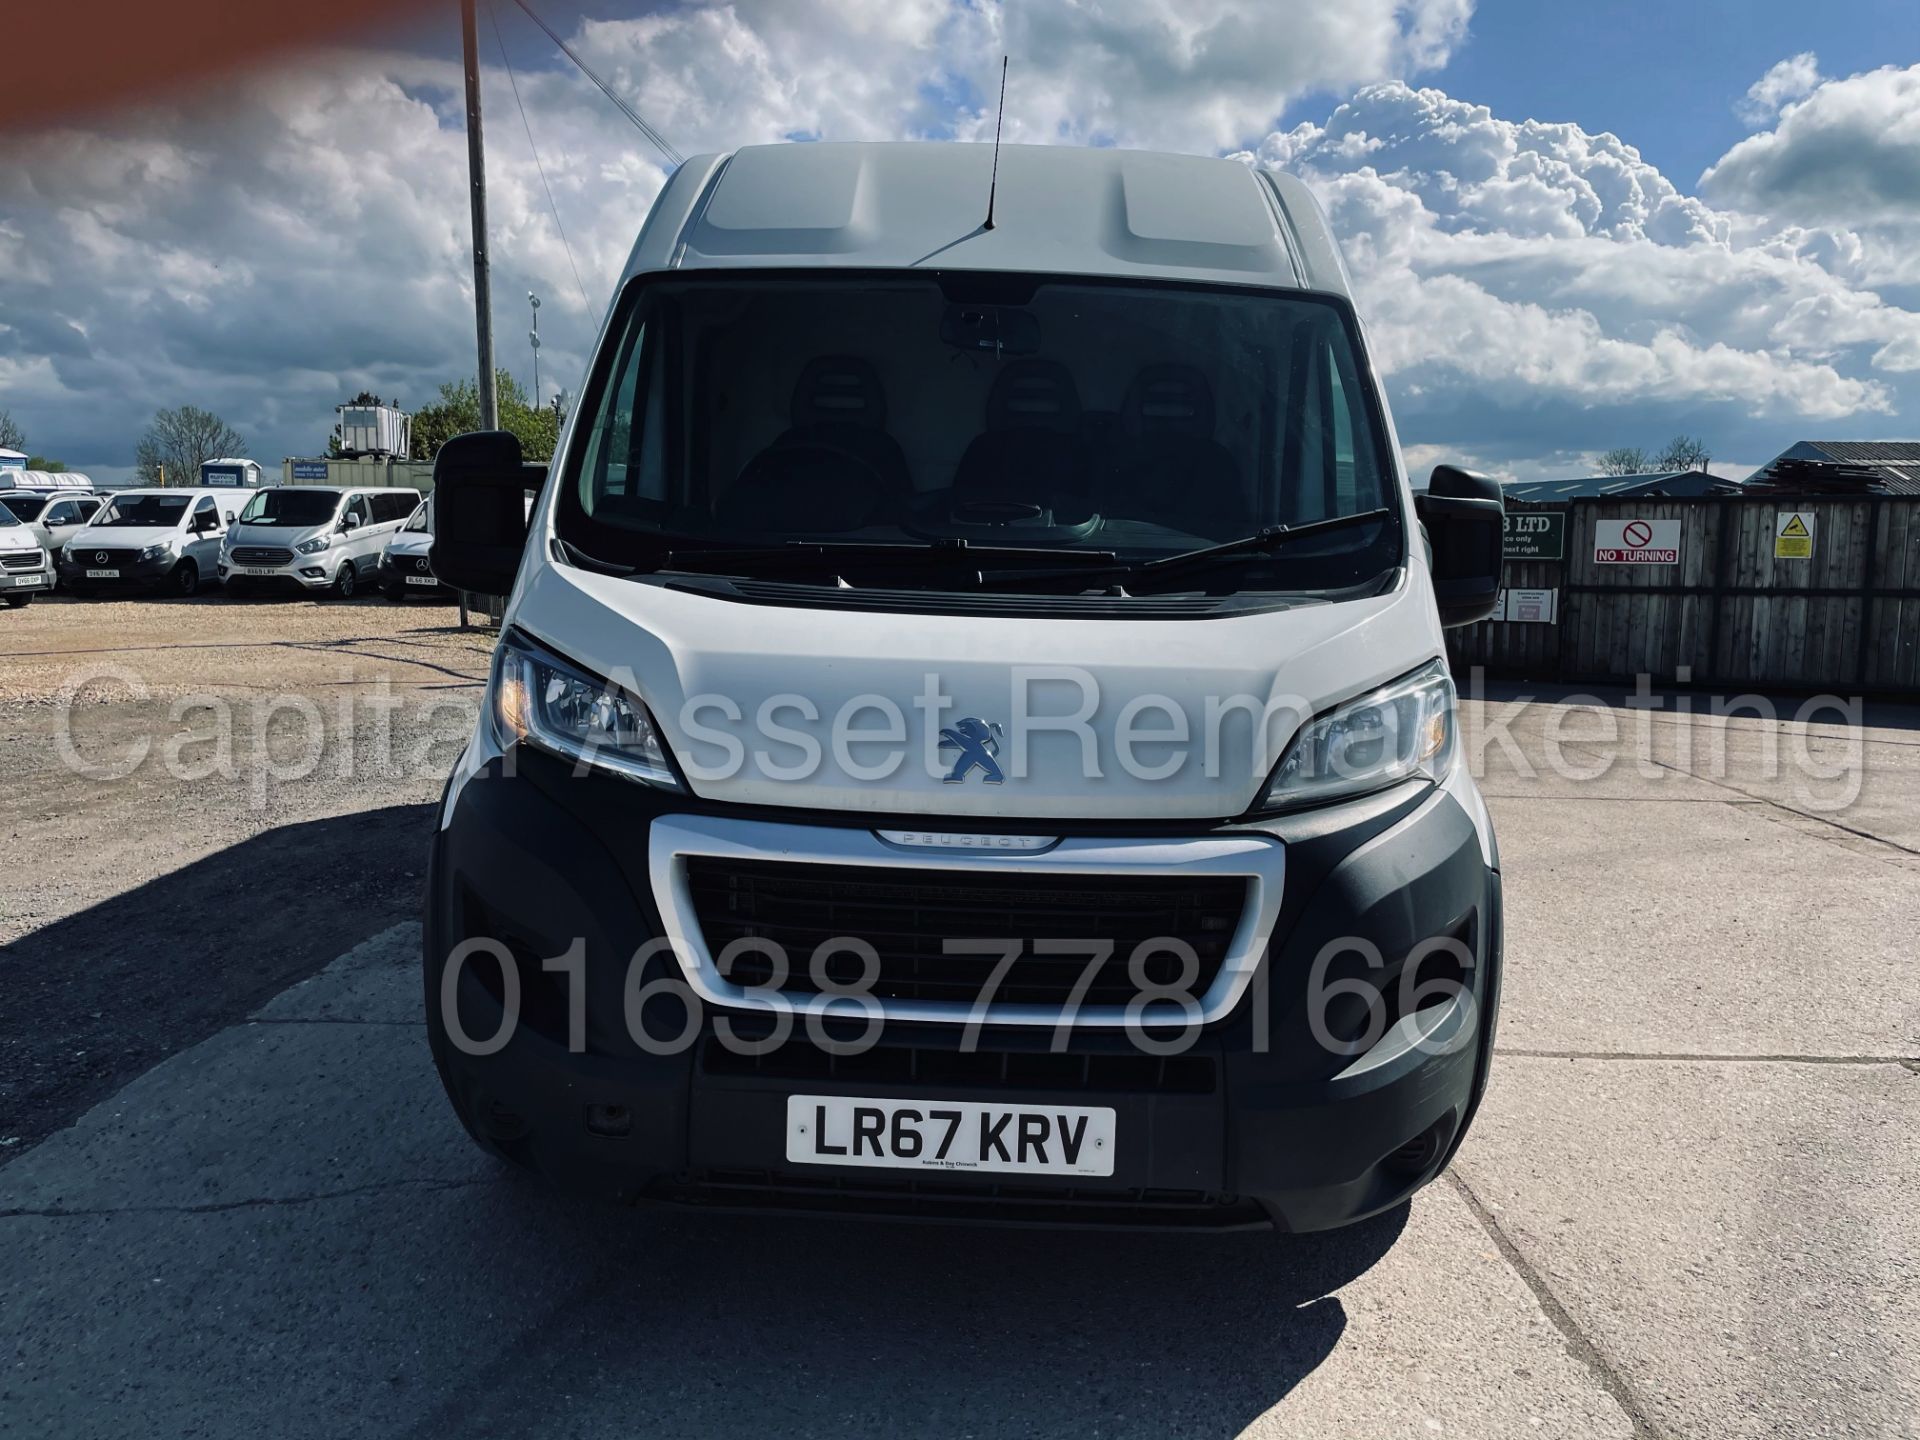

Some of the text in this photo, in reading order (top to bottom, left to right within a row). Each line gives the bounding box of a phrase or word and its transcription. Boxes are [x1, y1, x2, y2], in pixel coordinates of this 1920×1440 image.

[1516, 516, 1551, 532] LTD
[1515, 535, 1532, 544] only
[1521, 545, 1539, 554] right
[1599, 550, 1674, 562] NO TURNING
[903, 832, 1032, 848] PEUGEOT
[815, 1105, 1089, 1165] LR67 KRV
